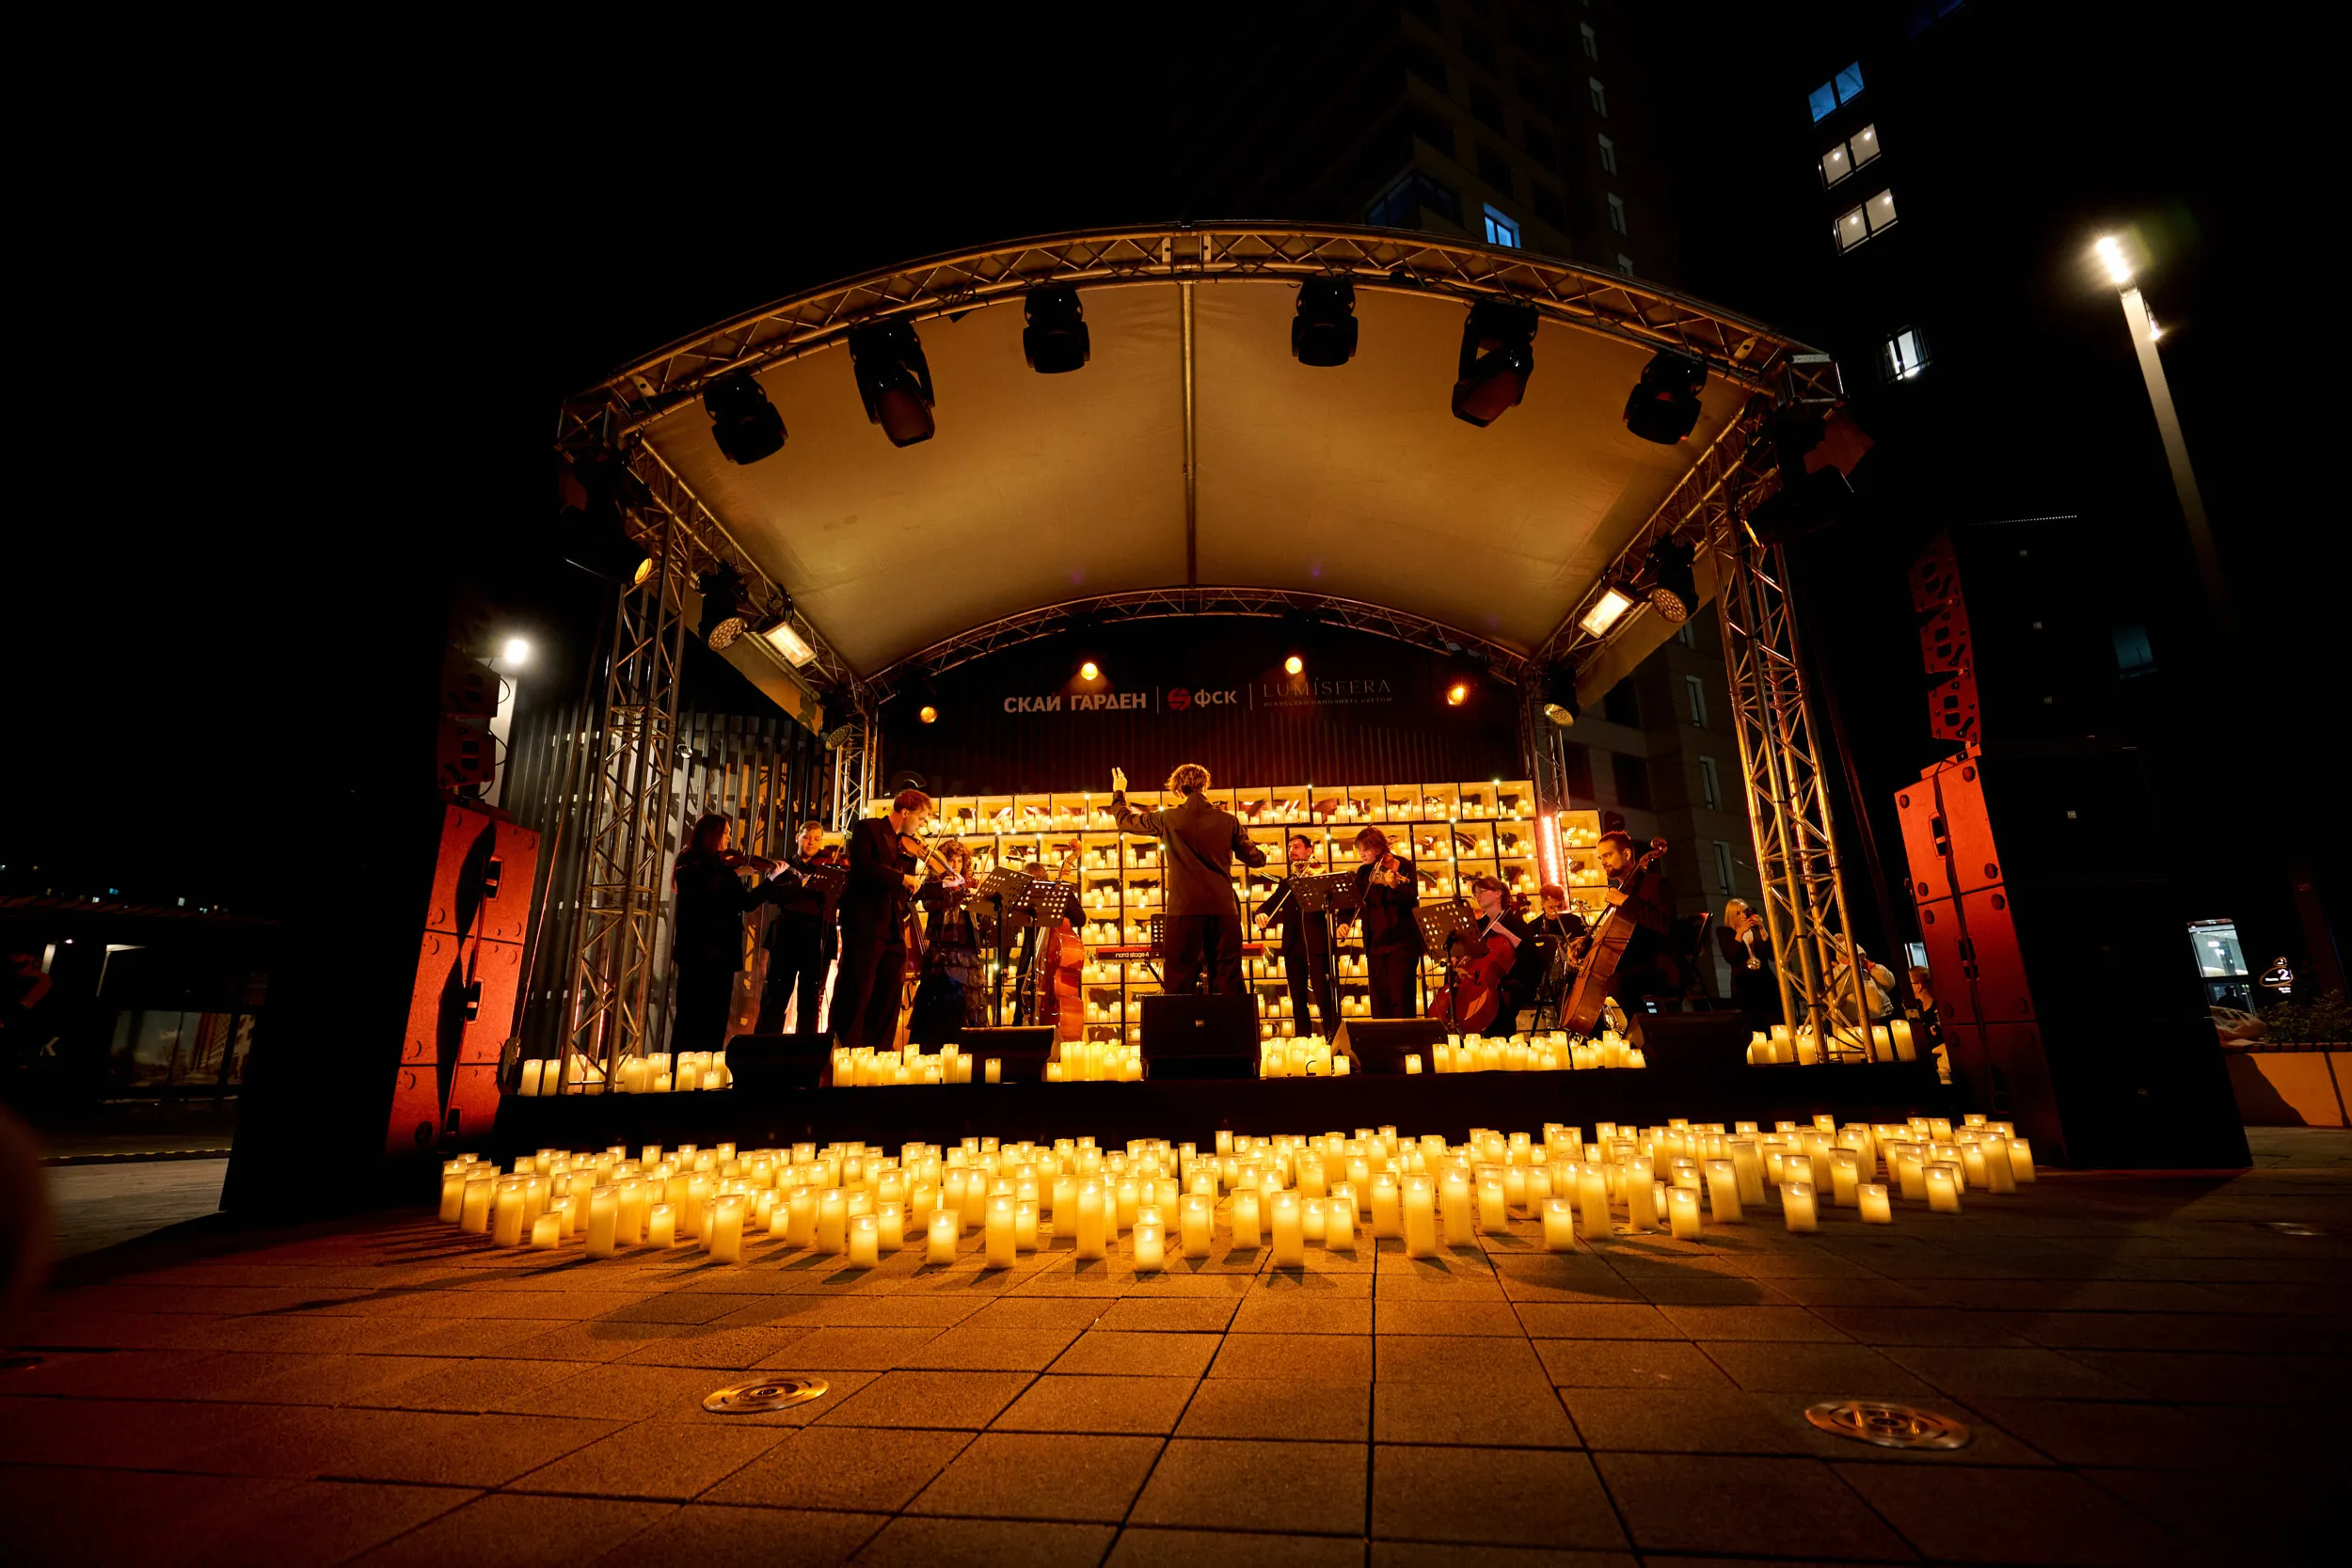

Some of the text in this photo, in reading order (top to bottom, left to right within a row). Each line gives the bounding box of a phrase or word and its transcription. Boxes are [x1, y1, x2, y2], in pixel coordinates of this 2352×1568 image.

[1004, 692, 1147, 713] СКАЙ ГАРДЕН
[2278, 968, 2291, 980] 2
